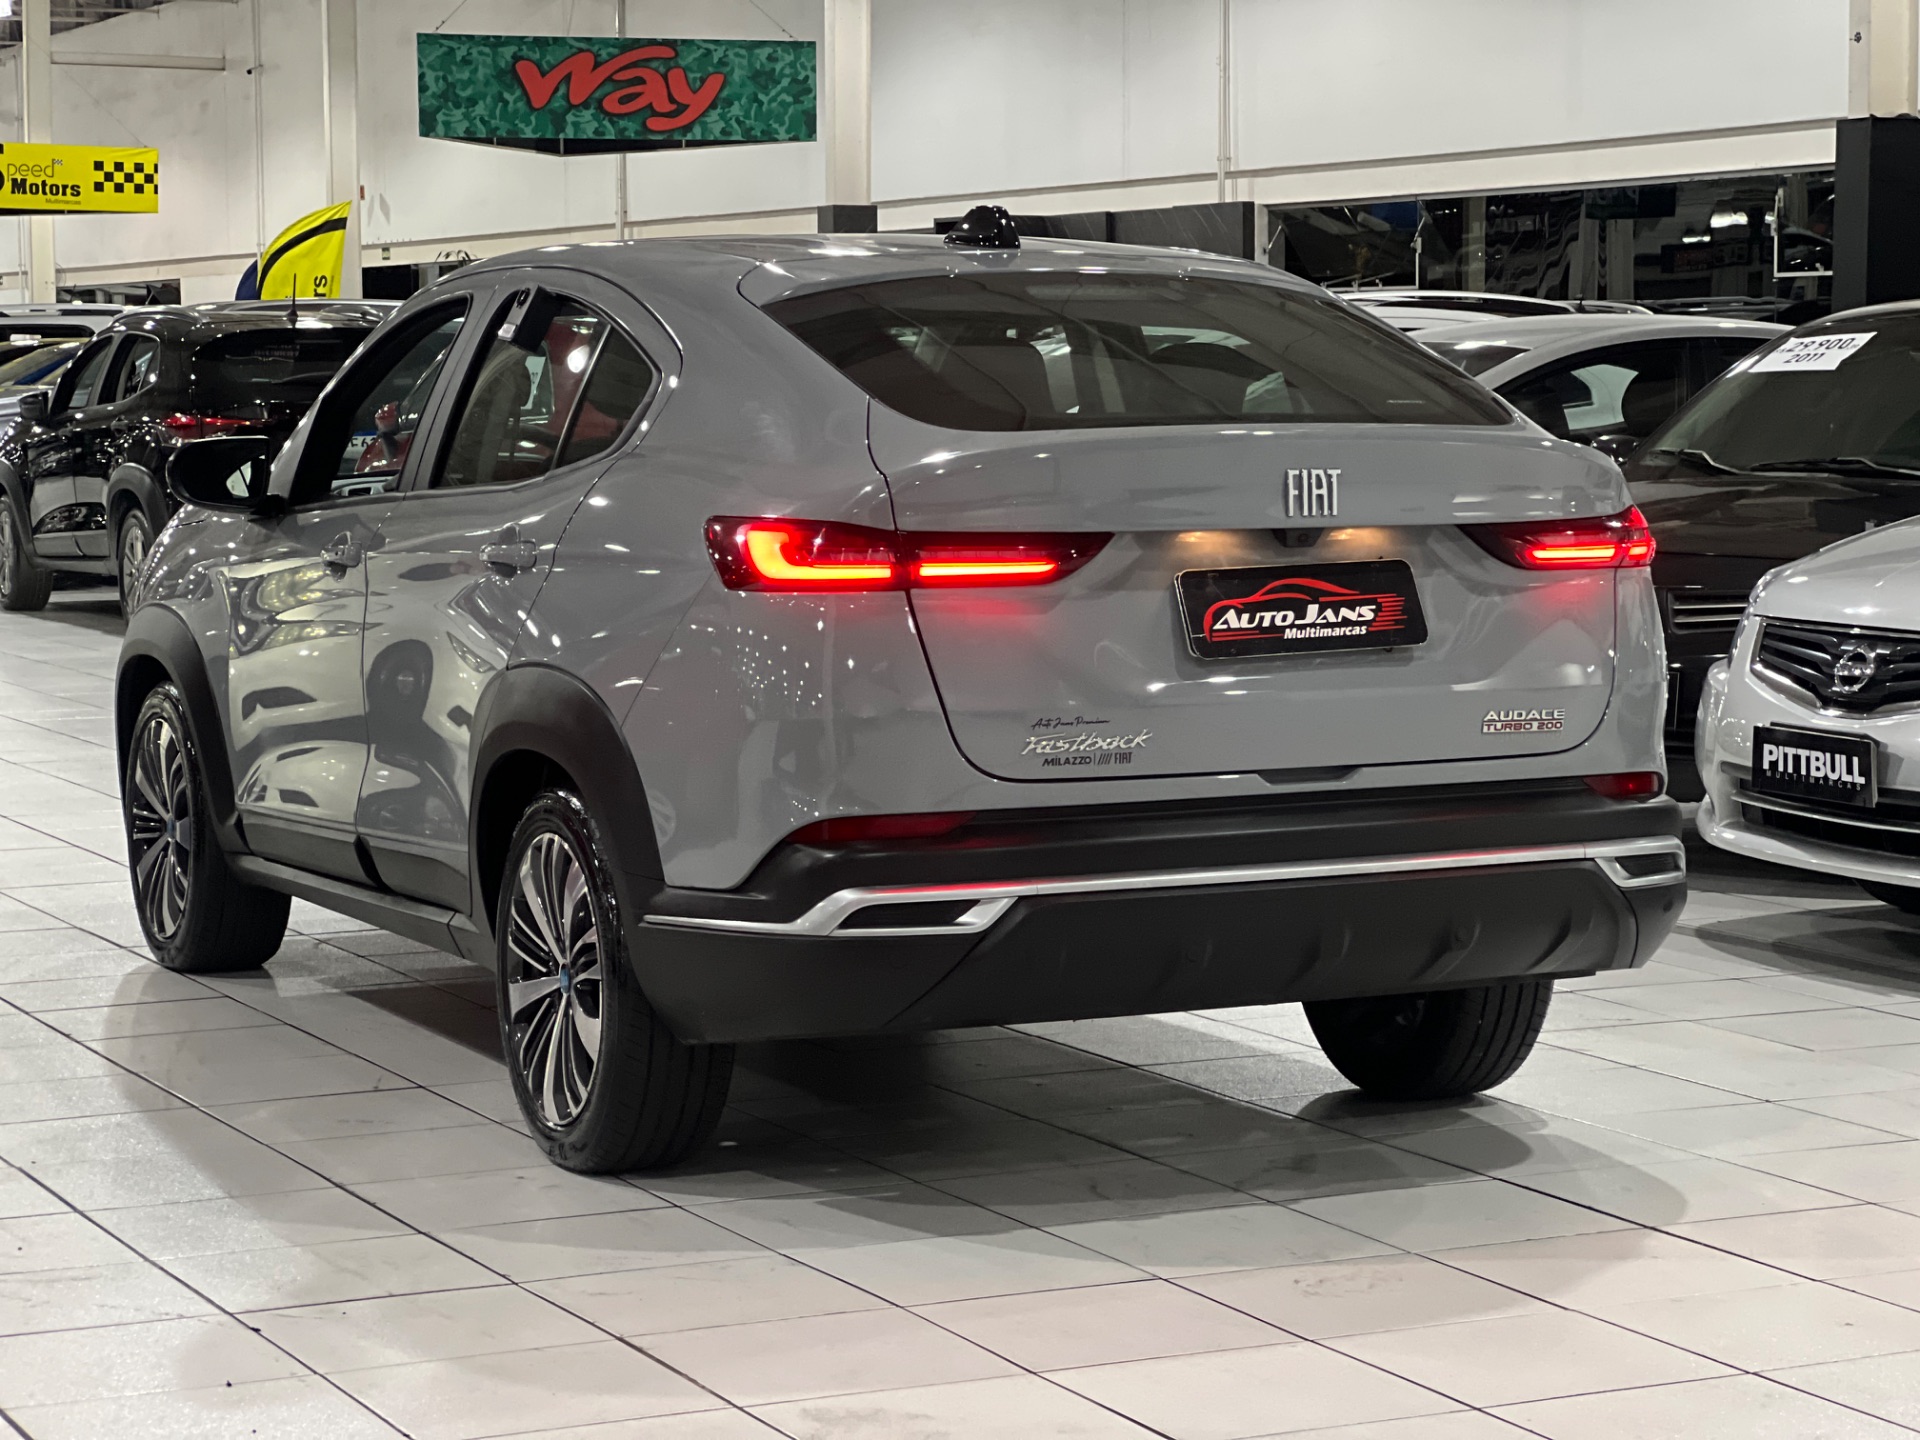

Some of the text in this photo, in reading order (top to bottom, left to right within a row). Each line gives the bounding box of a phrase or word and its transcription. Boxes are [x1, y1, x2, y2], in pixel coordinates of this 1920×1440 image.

[10, 177, 82, 198] Motors
[1783, 352, 1826, 364] 2011
[1285, 468, 1342, 517] FIAT
[1213, 603, 1377, 630] AUTO JANS
[1283, 625, 1368, 640] Multimarcas
[1483, 708, 1566, 721] AUDACE
[1484, 721, 1563, 732] TURBO 200
[1021, 728, 1153, 755] Fastback
[1114, 752, 1133, 764] FIAT
[1762, 743, 1866, 785] PITTBULL
[1766, 770, 1861, 791] MULTIMARCAS
